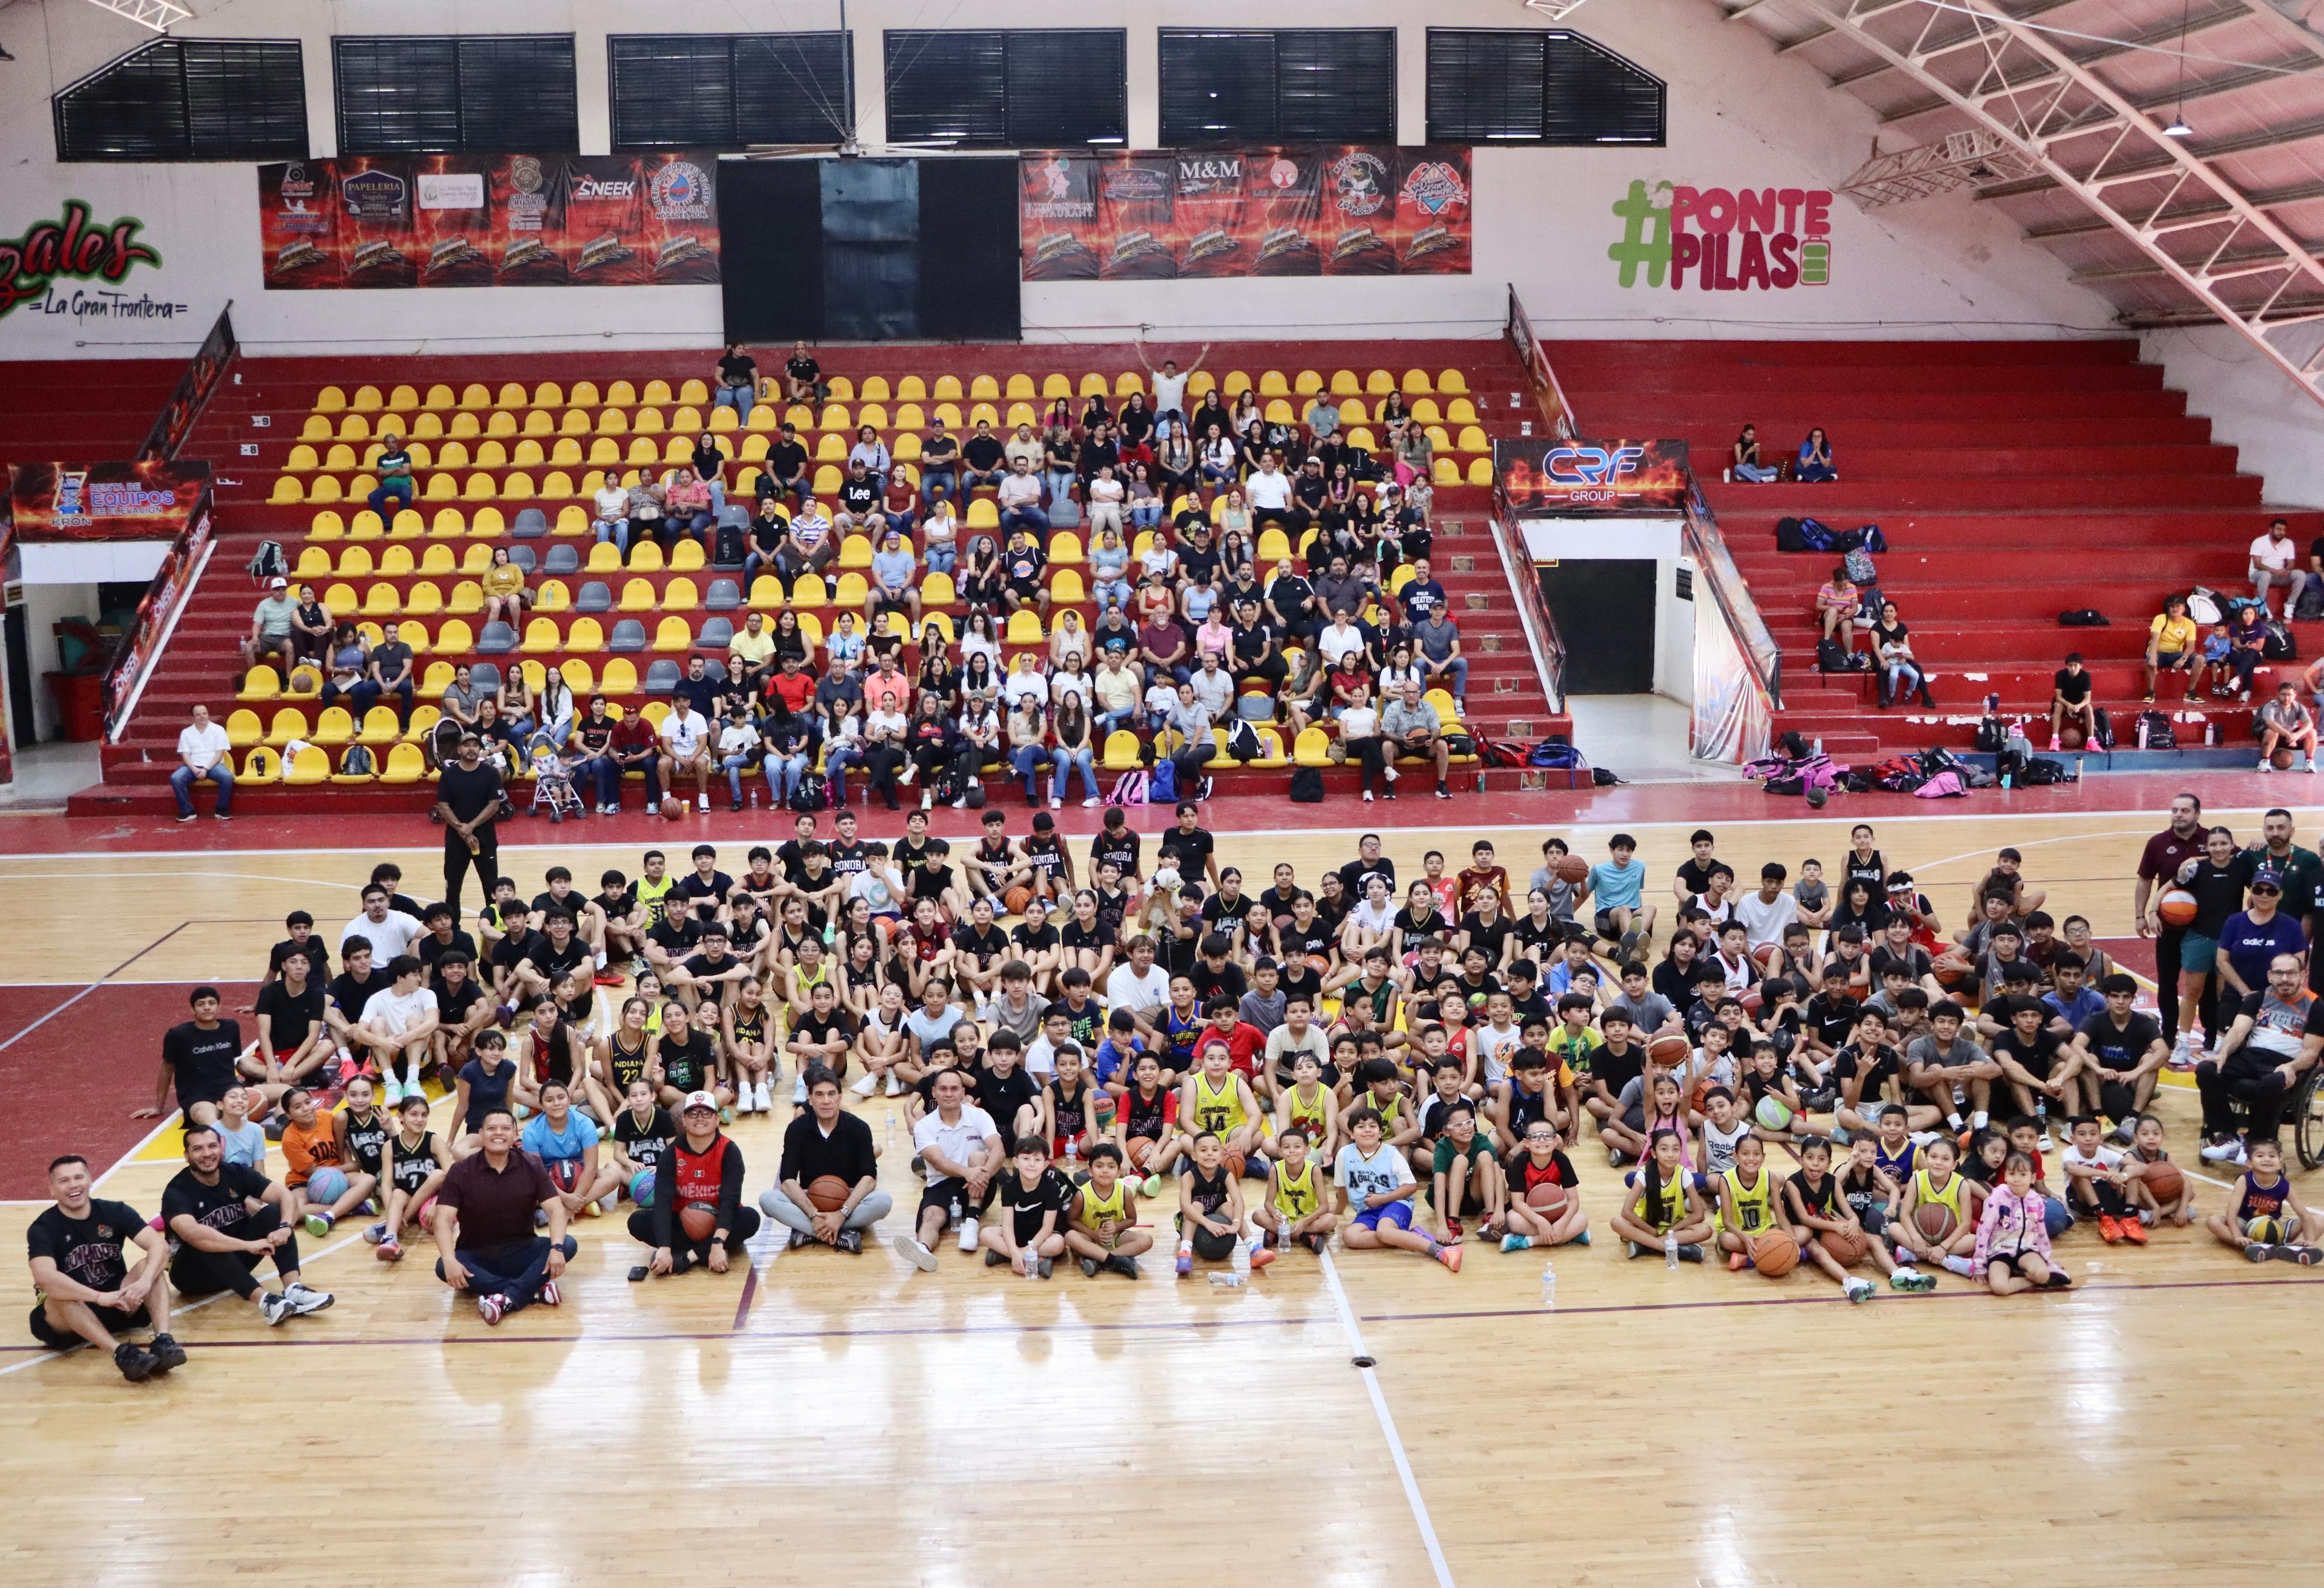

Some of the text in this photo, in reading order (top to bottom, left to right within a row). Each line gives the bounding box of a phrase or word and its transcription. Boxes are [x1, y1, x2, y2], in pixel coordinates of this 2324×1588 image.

[1180, 161, 1240, 179] M&M
[1334, 153, 1385, 174] REFACCIONARIA
[577, 181, 635, 196] SNEEK
[652, 176, 663, 207] SERVICIO
[660, 163, 701, 177] AUTOMOTRIZ
[1671, 186, 1833, 235] PONTE
[1671, 231, 1799, 291] PILAS
[45, 288, 174, 328] La Gran Frontera
[1543, 447, 1644, 486] CRF
[89, 483, 141, 491] RENTA DE
[849, 487, 870, 500] Lee
[91, 490, 175, 507] EQUIPOS
[1570, 491, 1614, 502] GROUP
[93, 507, 107, 515] DE
[52, 517, 92, 526] KRON
[1410, 596, 1435, 605] GREATEST
[1030, 853, 1060, 865] SONORA
[1103, 852, 1132, 862] SONORA
[834, 860, 866, 872] SONORA
[192, 1042, 233, 1054] Calvin Klein
[613, 1060, 644, 1068] NDIANA
[628, 1137, 667, 1157] AGUILAS
[641, 1153, 656, 1164] 51
[395, 1158, 435, 1179] AGUILAS
[409, 1174, 419, 1188] 7
[1741, 1207, 1760, 1231] 10
